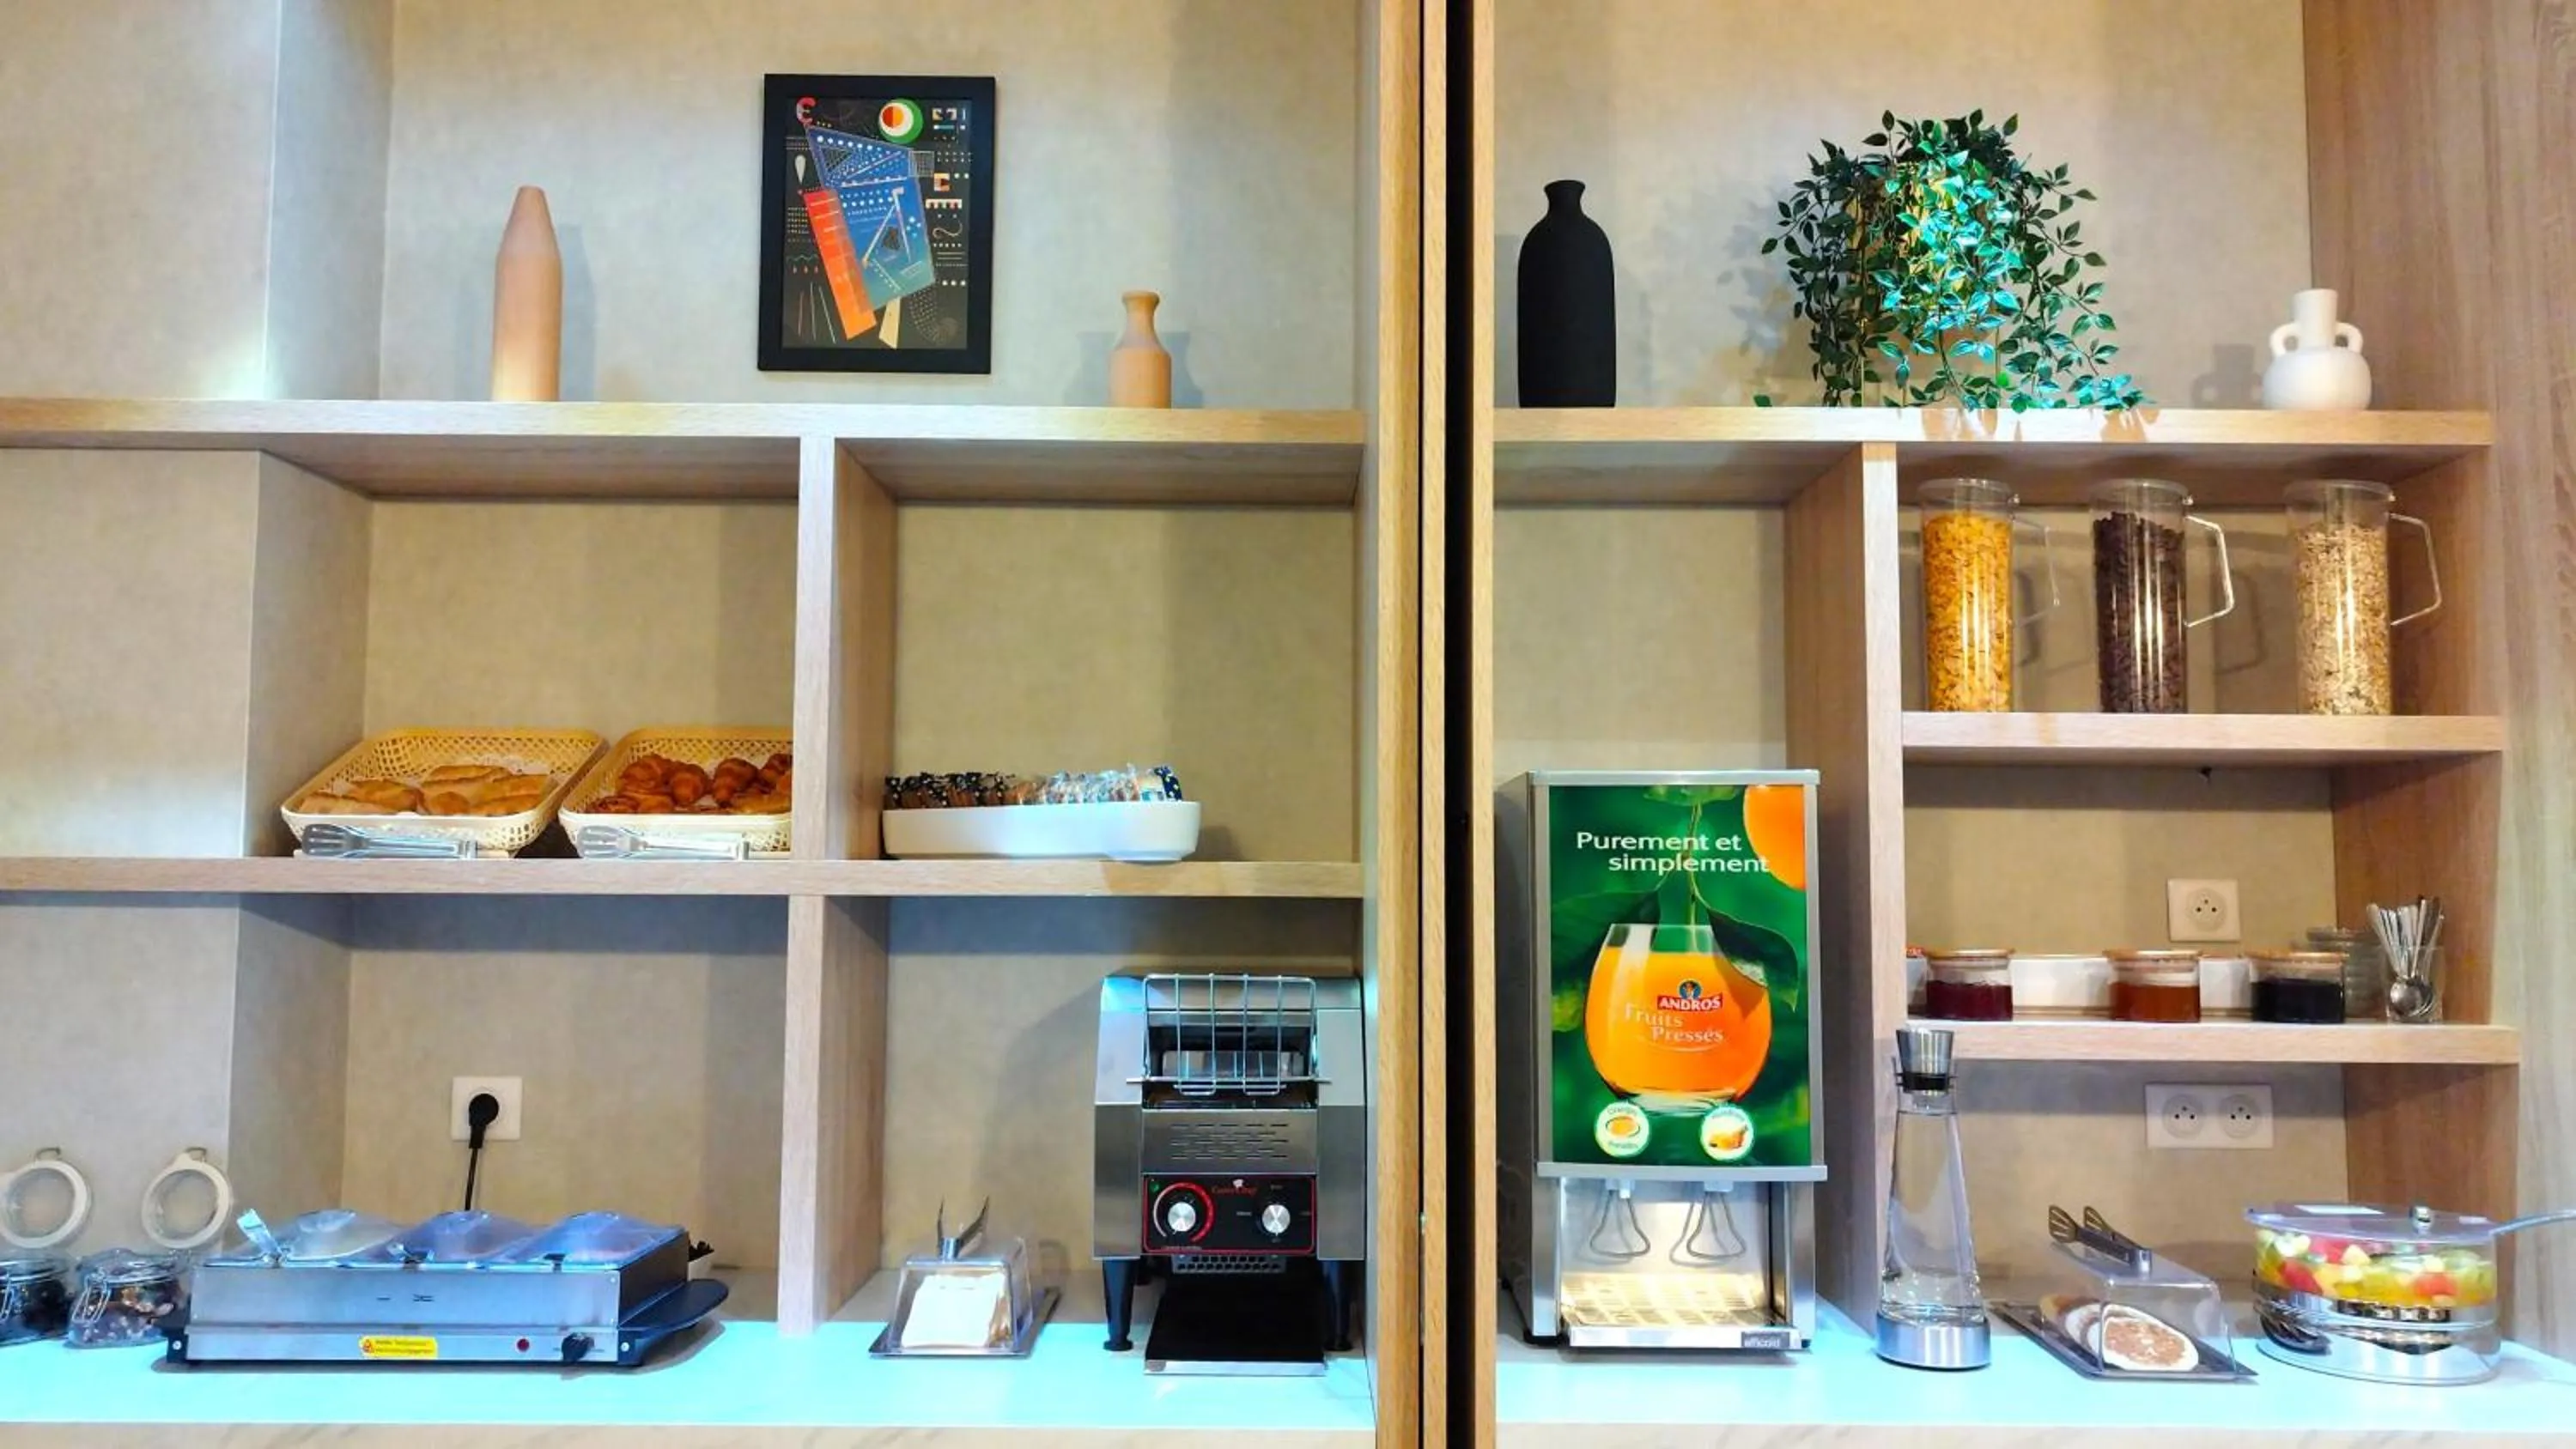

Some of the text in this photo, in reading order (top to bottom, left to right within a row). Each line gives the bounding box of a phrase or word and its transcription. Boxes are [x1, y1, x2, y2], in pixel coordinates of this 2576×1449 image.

[1577, 831, 1742, 851] Purement et
[1608, 852, 1771, 876] simplement
[1659, 995, 1722, 1010] ANDROS
[1625, 1001, 1684, 1028] Fruits
